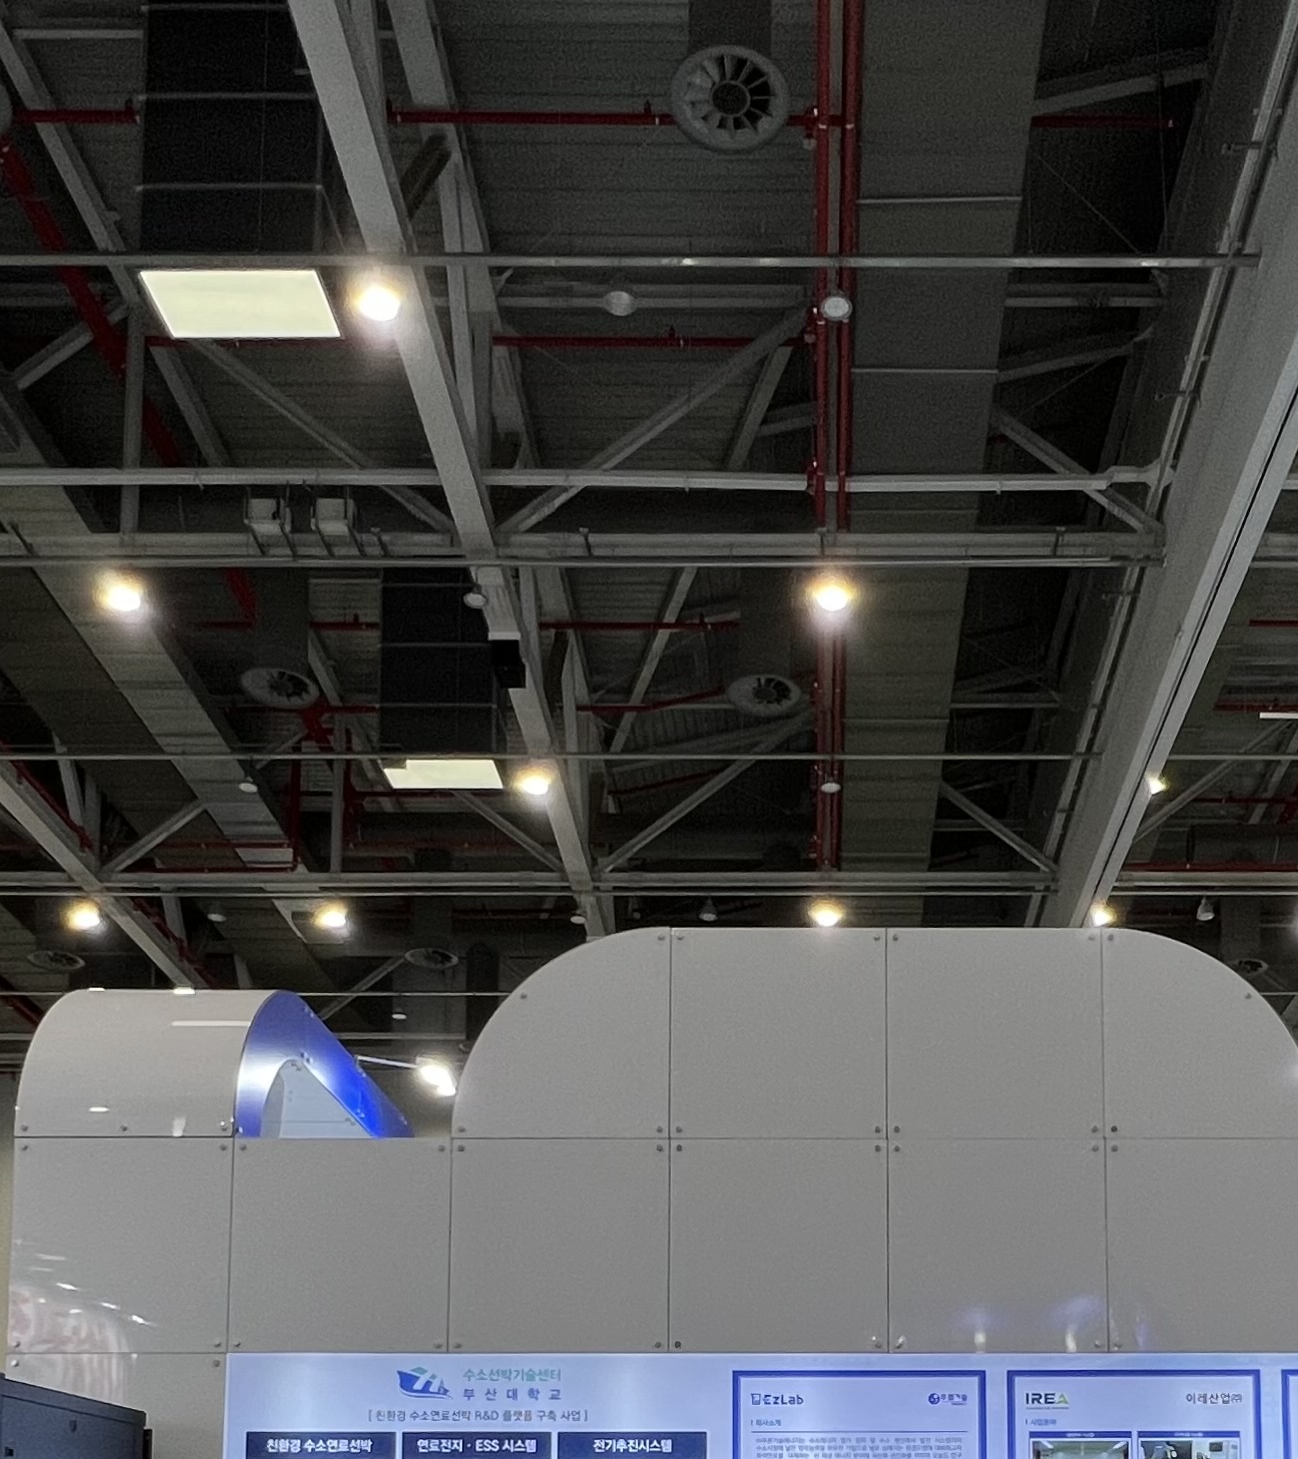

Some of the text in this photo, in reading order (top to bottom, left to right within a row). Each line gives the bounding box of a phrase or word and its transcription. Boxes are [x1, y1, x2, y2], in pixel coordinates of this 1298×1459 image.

[463, 1368, 562, 1382] 수소선박기술센터
[763, 1394, 804, 1406] EzLab
[1025, 1392, 1070, 1405] IREA
[375, 1410, 582, 1422] 친환경 수소연료선박 R&D 플랫폼 구축 사업
[266, 1438, 373, 1453] 친환경 수소연료선박
[417, 1438, 537, 1453] 연료전지 ESS 시스템
[593, 1438, 673, 1453] 전기추진시스템
